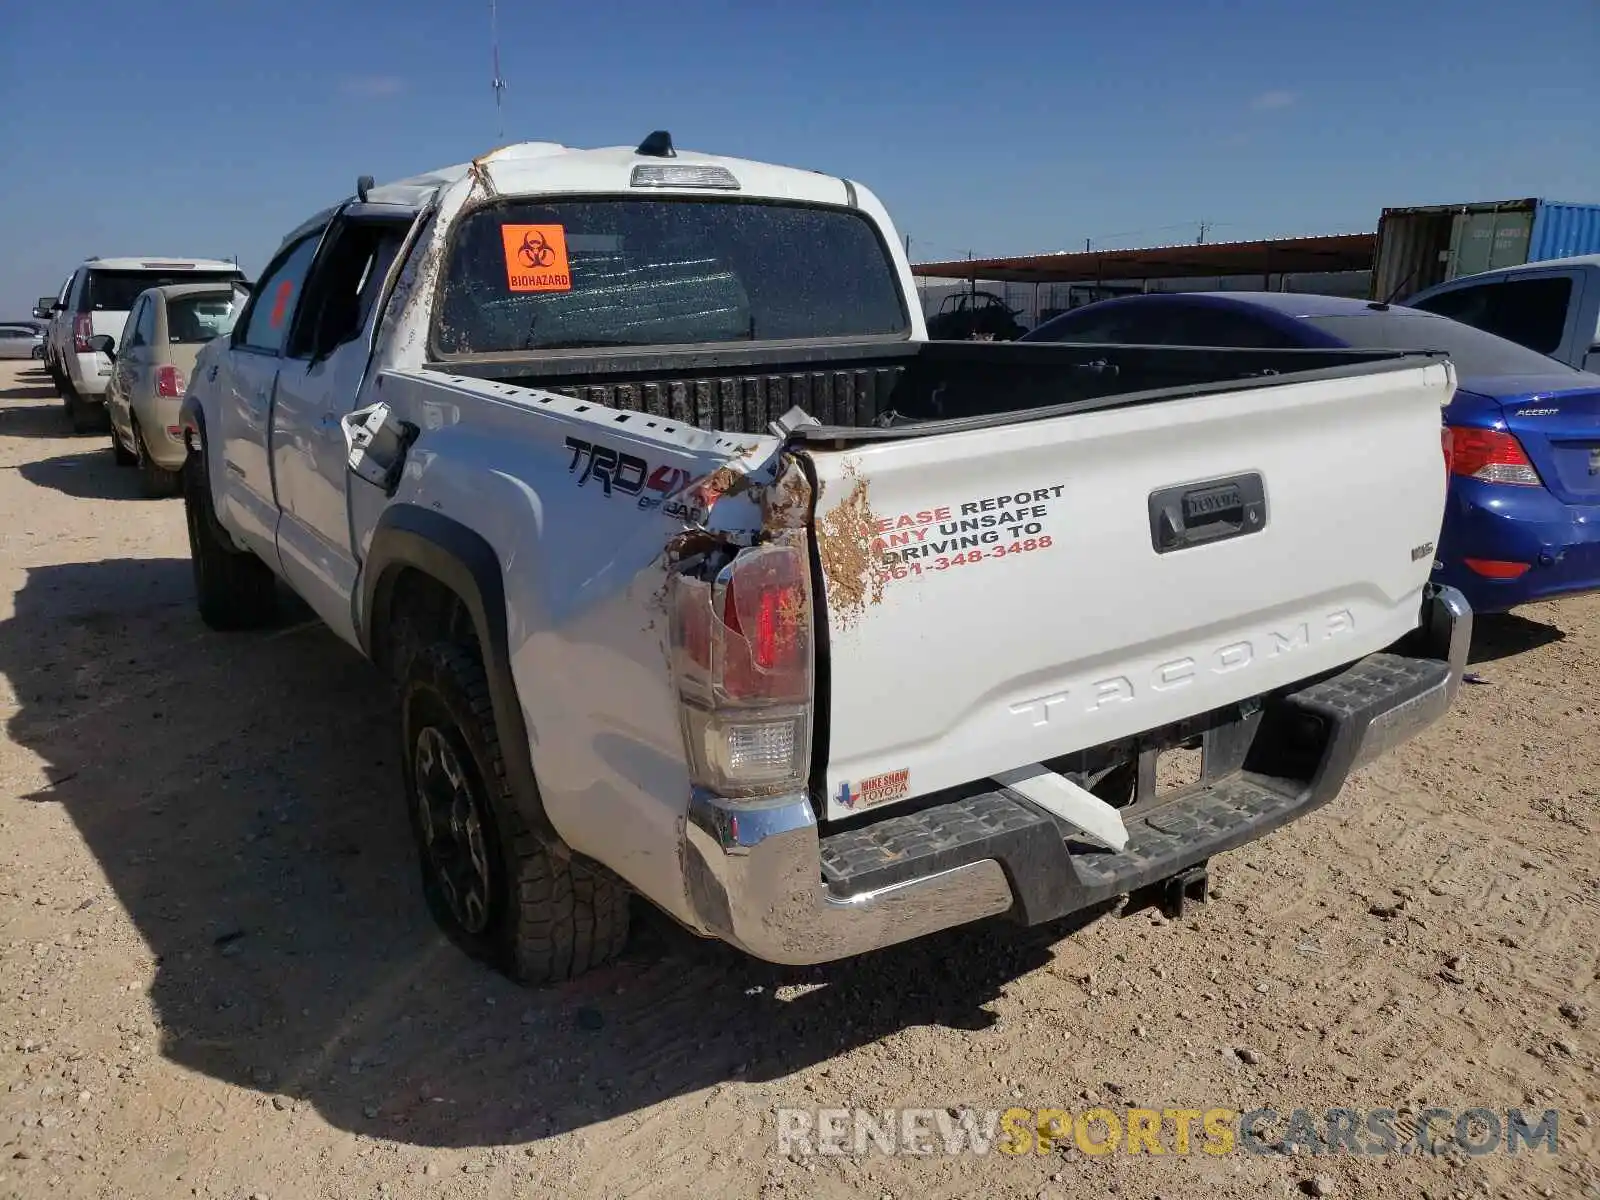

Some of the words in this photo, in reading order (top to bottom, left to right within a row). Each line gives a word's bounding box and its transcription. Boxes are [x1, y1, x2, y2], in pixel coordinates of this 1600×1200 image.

[510, 274, 568, 287] BIOHAZARD
[1515, 408, 1559, 417] ACCENT
[858, 506, 951, 537] EASE
[961, 484, 1065, 516] REPORT
[869, 527, 929, 553] ANY
[939, 504, 1047, 536] UNSAFE
[881, 530, 999, 565] DRIVING
[1007, 522, 1042, 538] TO
[1008, 608, 1354, 727] TACOMA
[861, 777, 883, 792] MIKE
[883, 769, 908, 786] SHAW
[863, 782, 908, 801] TOYOTA
